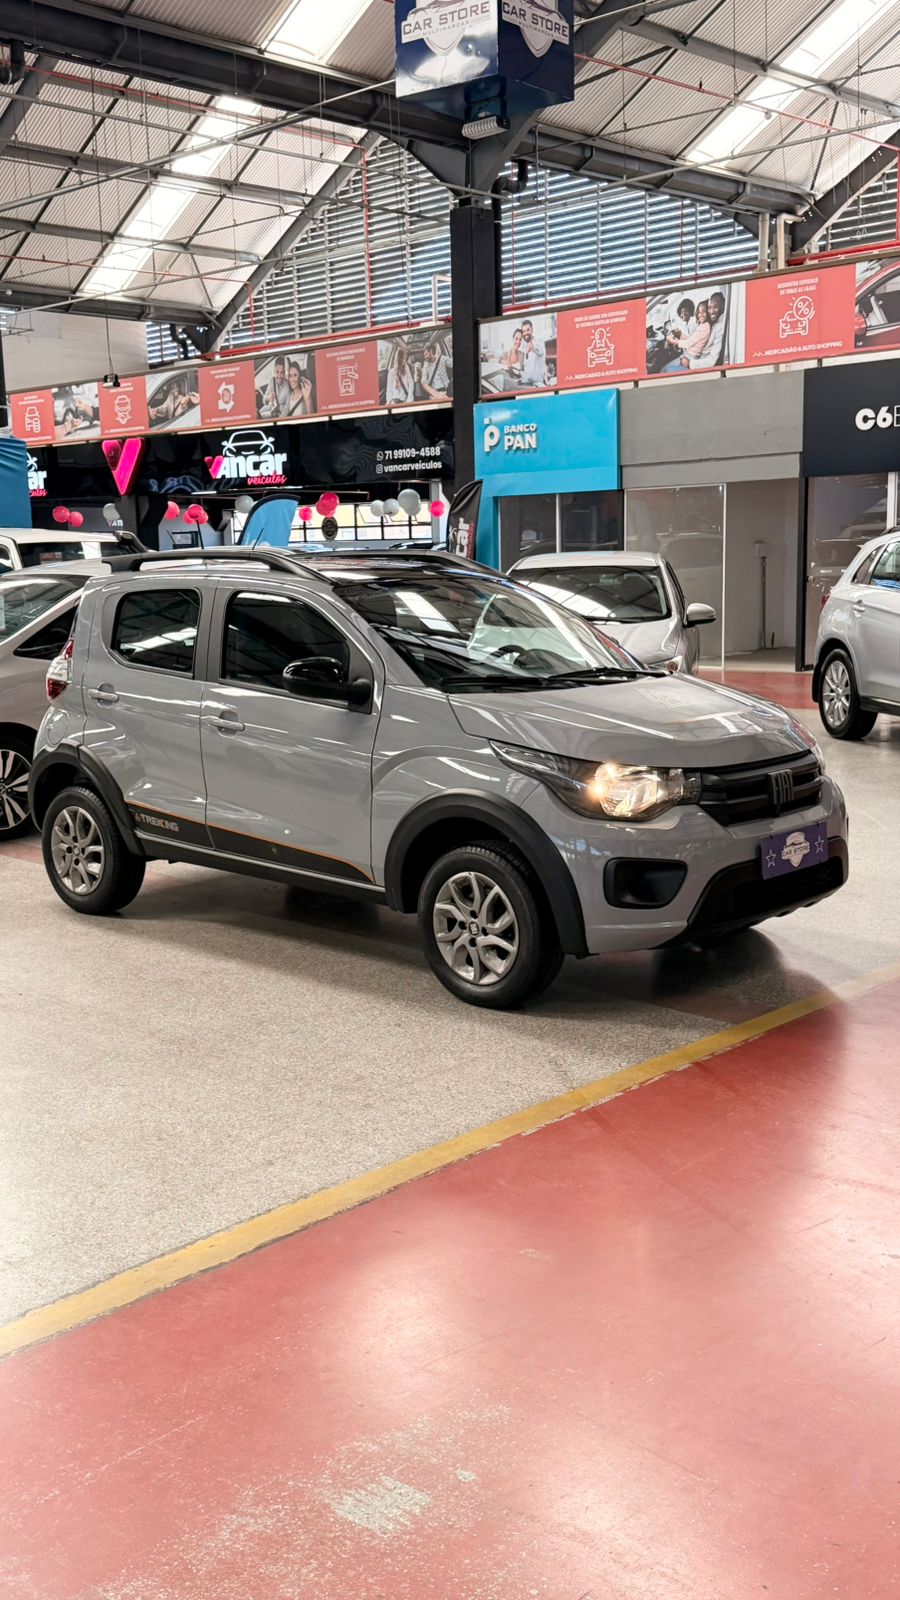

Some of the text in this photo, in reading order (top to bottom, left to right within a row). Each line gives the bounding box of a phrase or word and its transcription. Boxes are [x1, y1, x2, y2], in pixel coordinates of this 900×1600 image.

[403, 1, 490, 36] CAR STORE
[503, 4, 568, 38] CAR STORE
[422, 20, 470, 37] MULTIMARCAS
[518, 20, 555, 38] MULTIMARCAS
[504, 423, 537, 434] BANCO
[504, 434, 538, 451] PAN
[384, 446, 441, 460] 71 99109-4588
[384, 460, 442, 472] vancarveiculos
[770, 769, 794, 804] FIAT
[782, 844, 810, 857] CAR STORE
